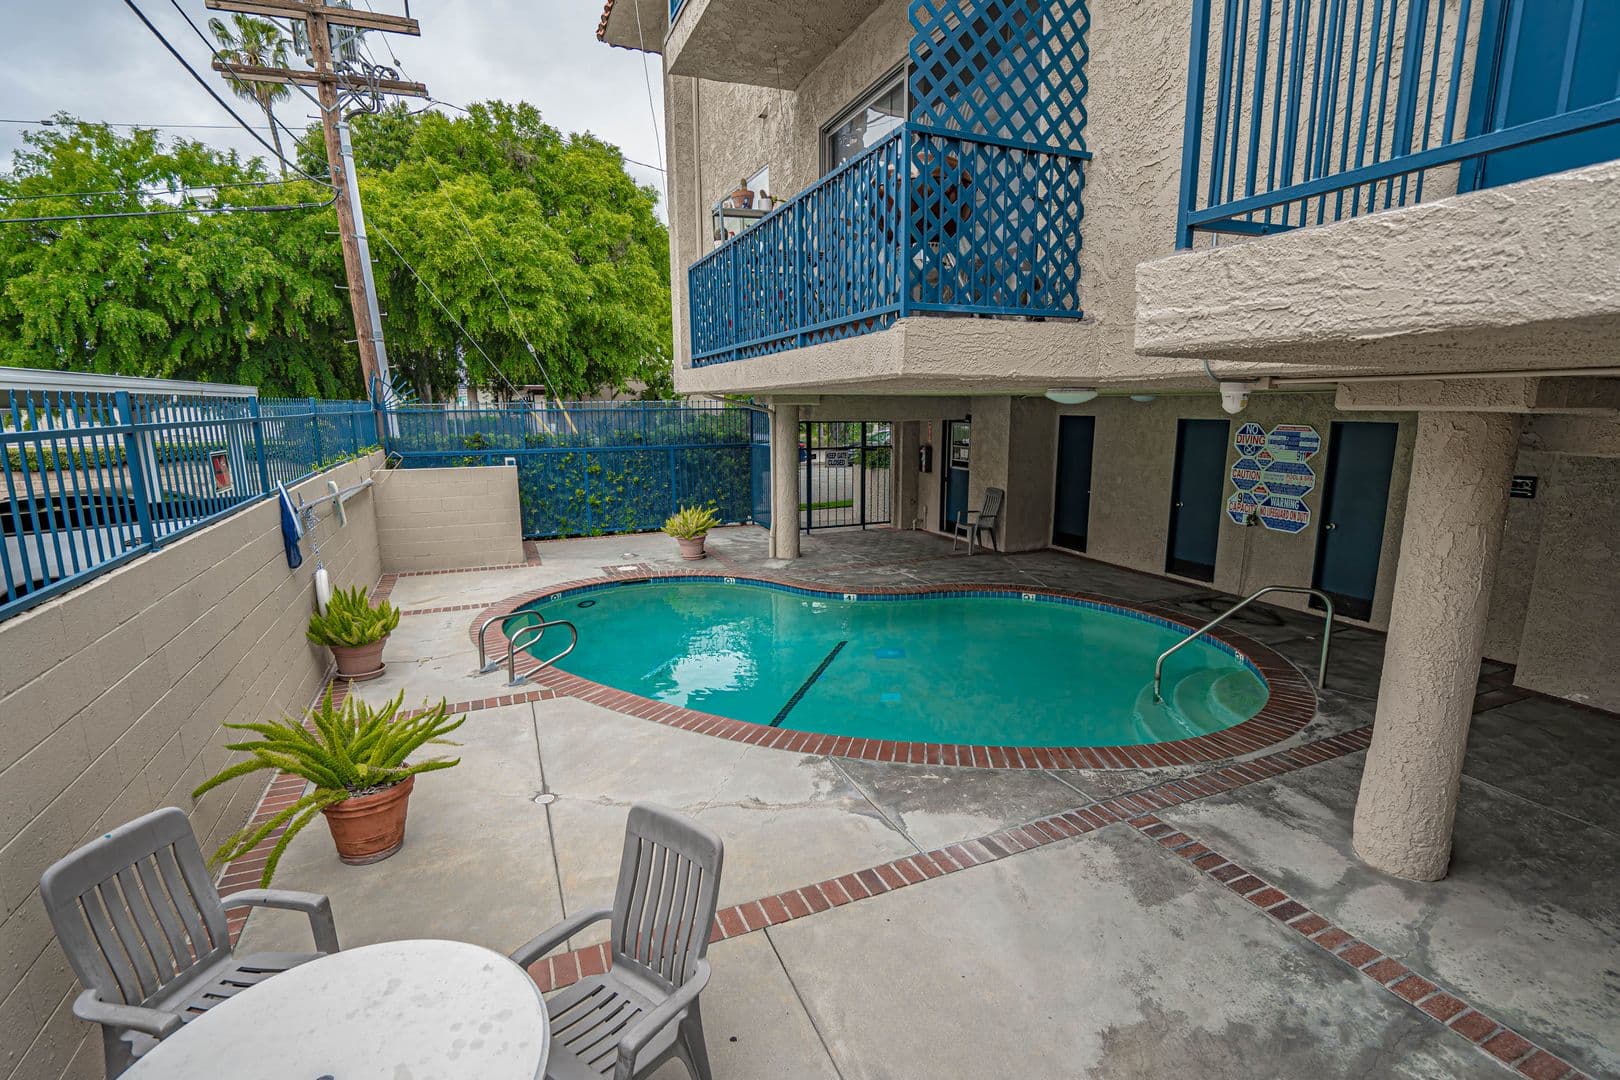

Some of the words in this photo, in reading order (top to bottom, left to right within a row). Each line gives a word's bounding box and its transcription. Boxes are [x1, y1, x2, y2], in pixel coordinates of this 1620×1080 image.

[1246, 425, 1259, 434] NO
[1236, 435, 1265, 445] DIVING
[1232, 469, 1261, 480] CAUTION
[1270, 497, 1299, 509] WARNING
